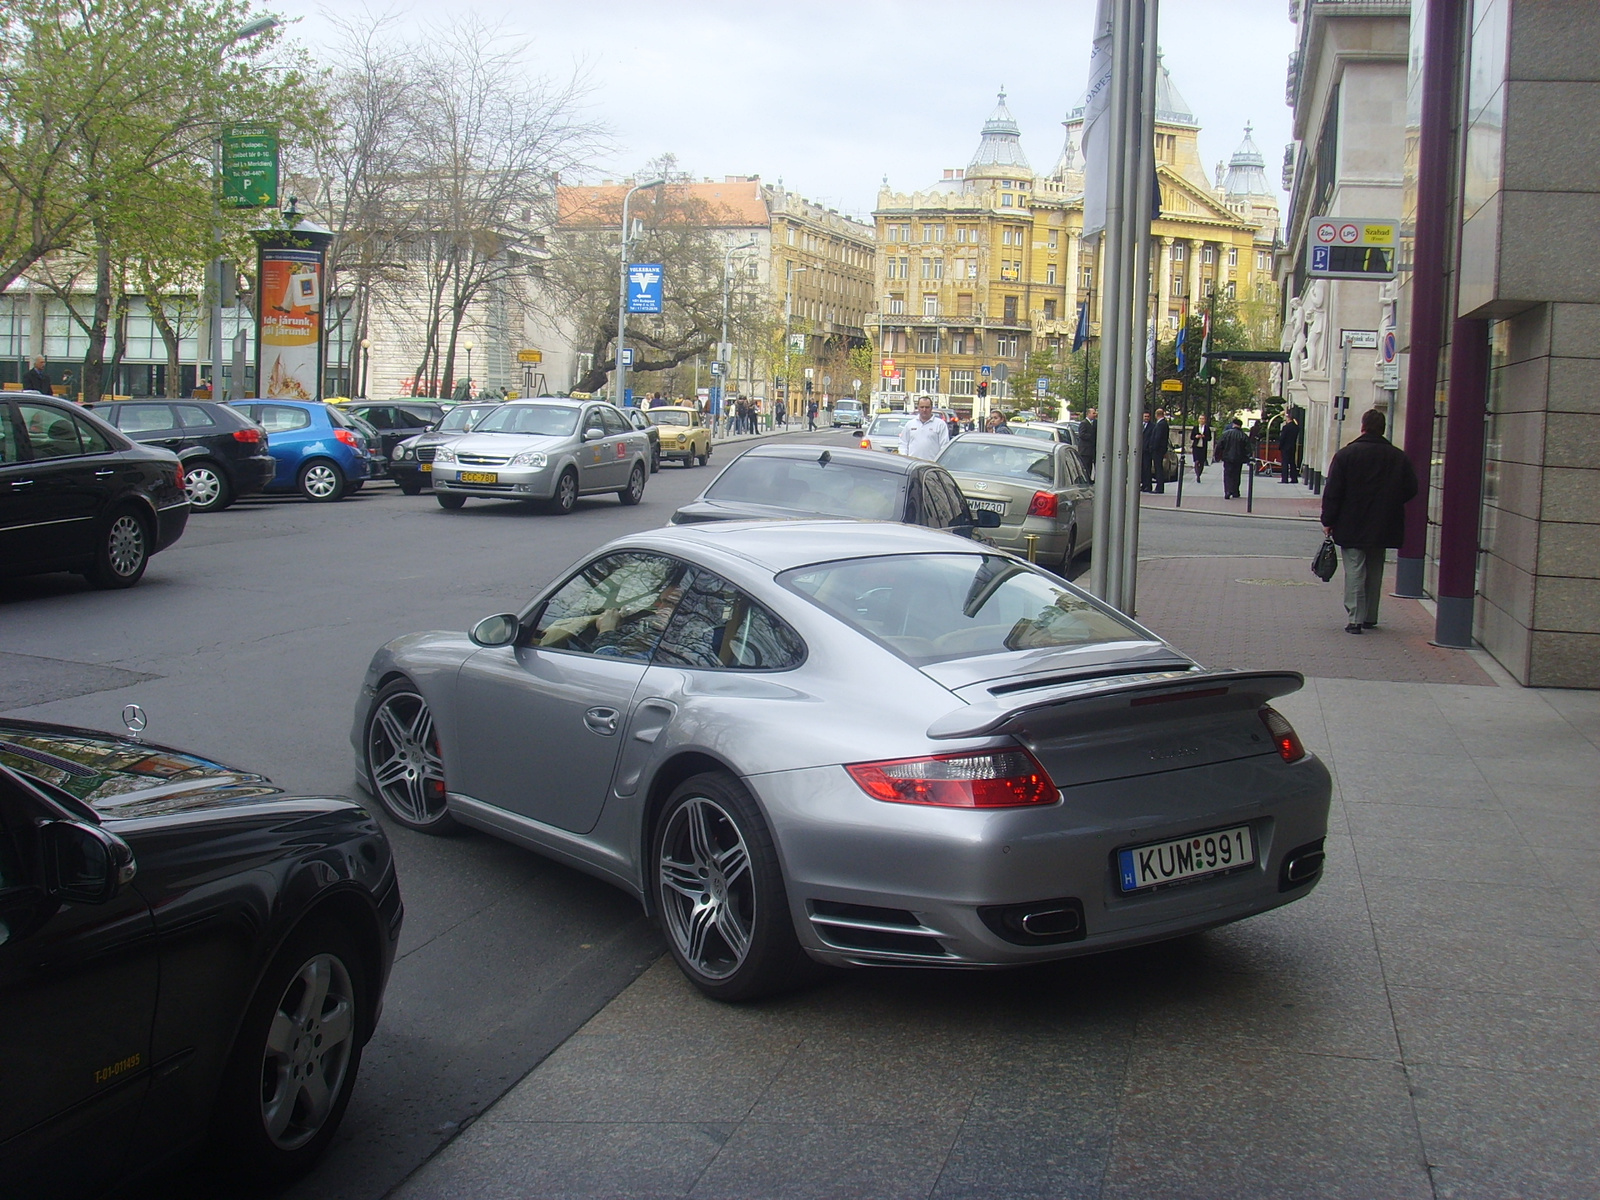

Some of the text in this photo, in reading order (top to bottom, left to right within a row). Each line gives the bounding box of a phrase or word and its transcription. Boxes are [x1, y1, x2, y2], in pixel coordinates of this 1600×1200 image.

[244, 179, 252, 189] P
[1365, 228, 1390, 236] Szabad
[1316, 250, 1325, 261] P
[263, 315, 313, 327] Ide járunk,
[275, 326, 310, 336] járunk!
[1124, 873, 1132, 884] H
